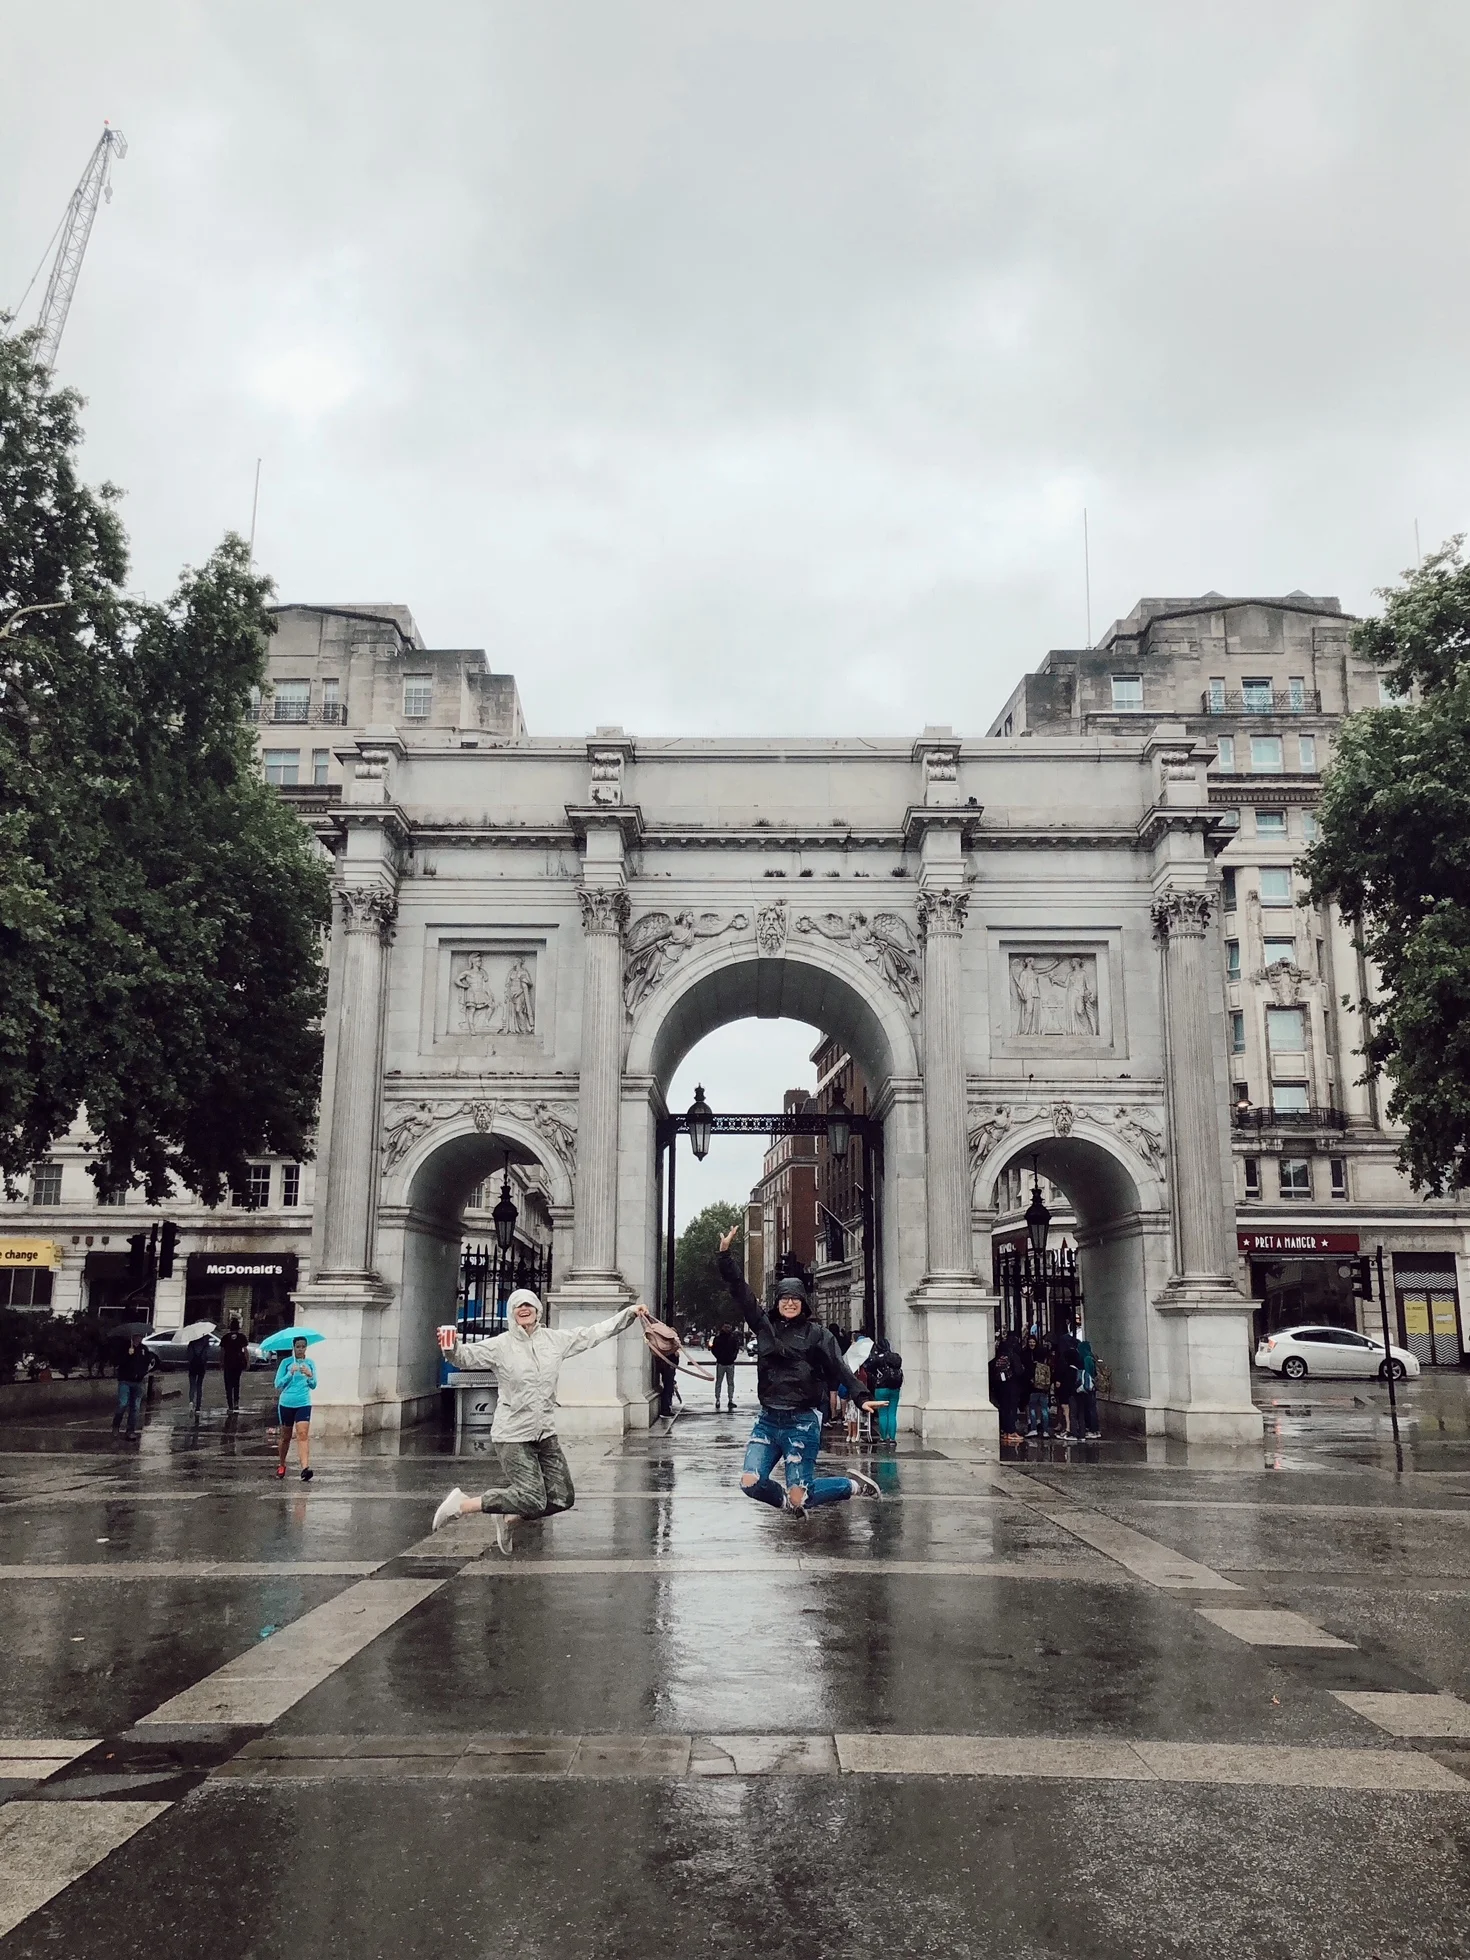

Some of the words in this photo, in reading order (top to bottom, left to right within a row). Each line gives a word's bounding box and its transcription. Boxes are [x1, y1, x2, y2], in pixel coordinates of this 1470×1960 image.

[1255, 1236, 1273, 1248] PRET
[1276, 1237, 1282, 1248] A
[1284, 1236, 1316, 1249] MANGER
[5, 1249, 38, 1262] change
[206, 1264, 283, 1275] McDonald's
